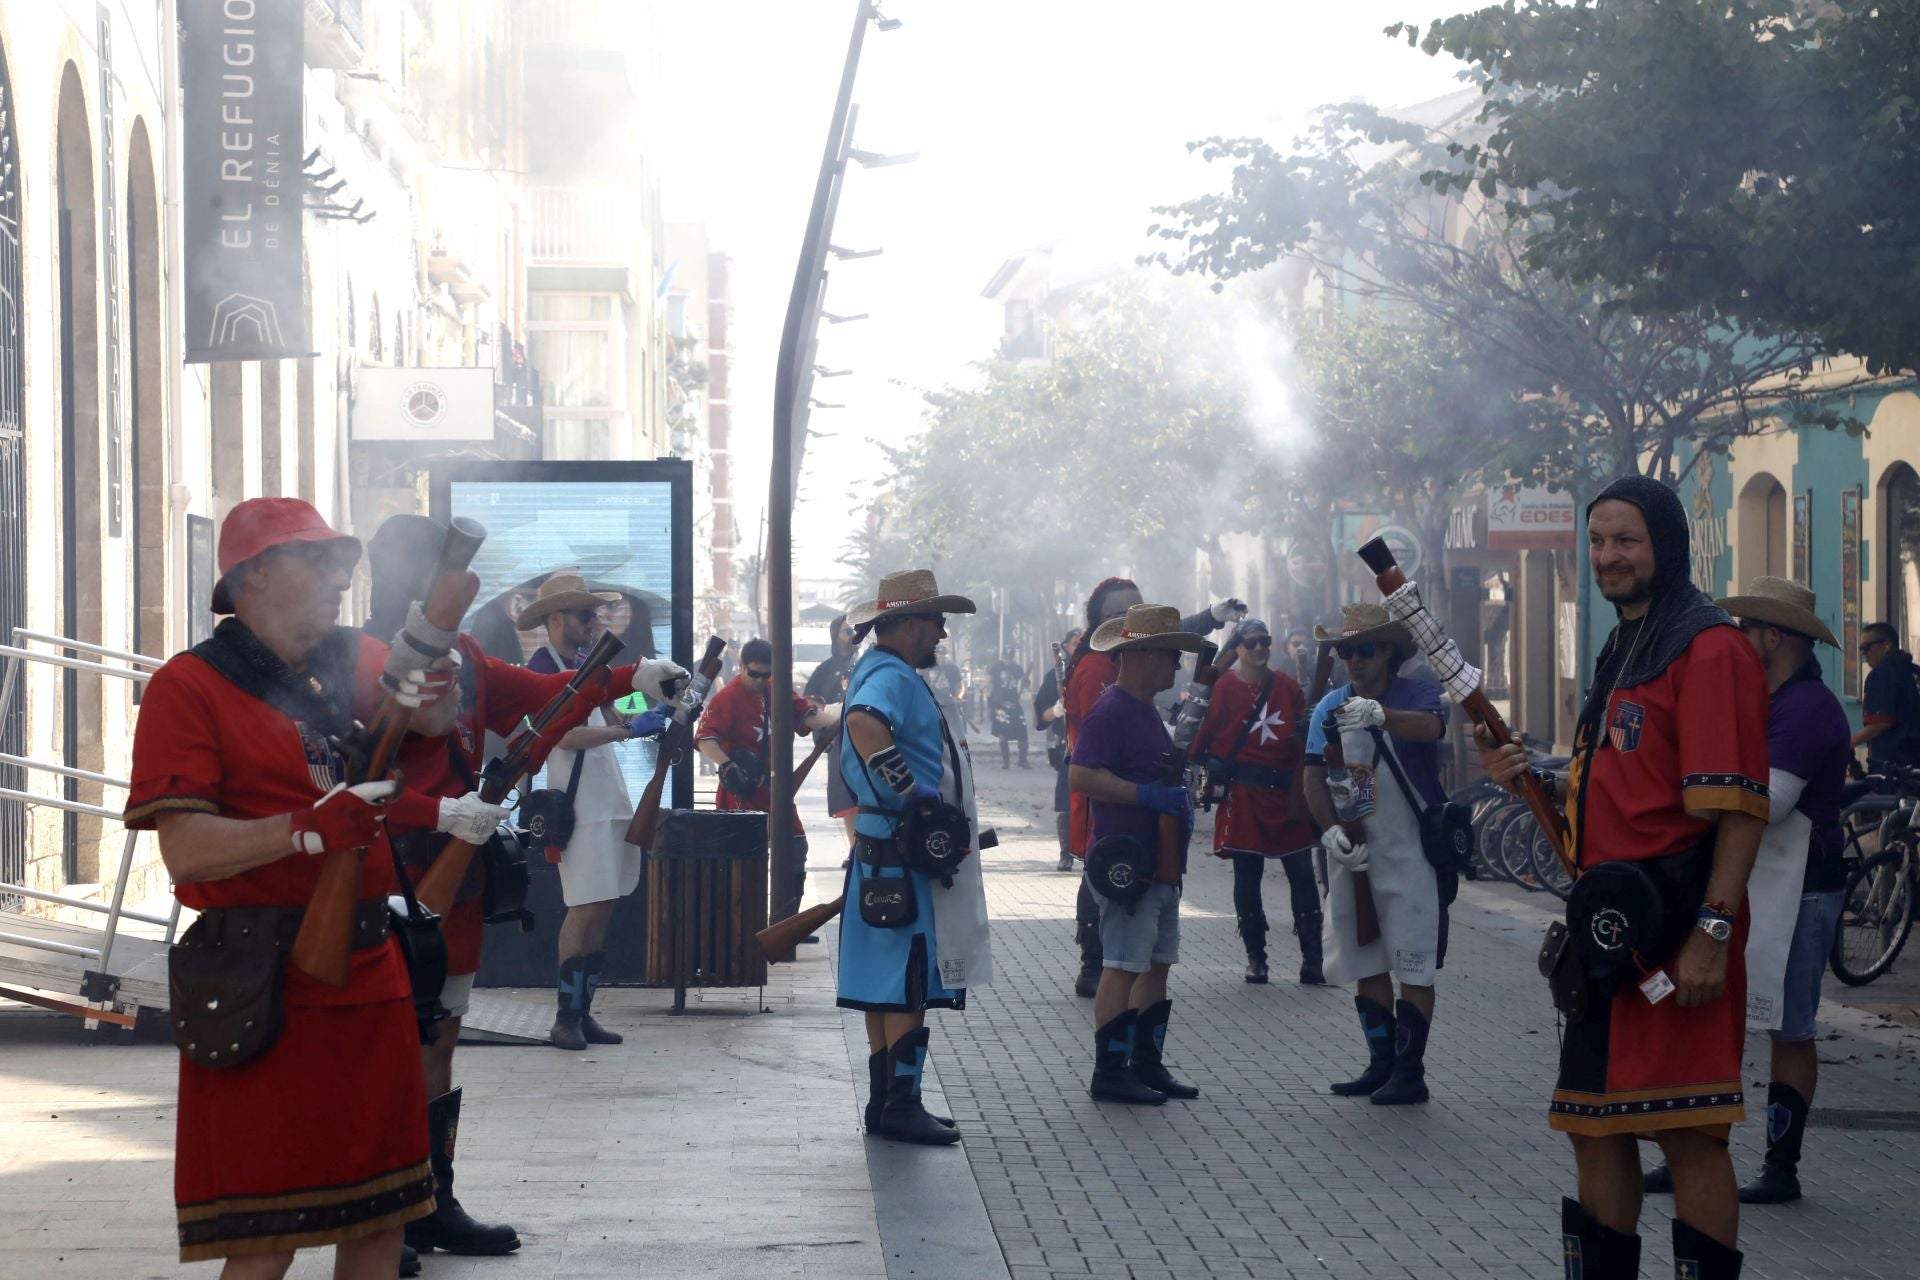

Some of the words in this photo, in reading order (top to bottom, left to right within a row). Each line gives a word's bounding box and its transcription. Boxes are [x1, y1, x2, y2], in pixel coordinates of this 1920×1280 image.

[221, 0, 255, 182] REFUGIO
[263, 134, 280, 206] DÉNIA
[221, 203, 252, 249] EL
[265, 223, 279, 249] DE
[102, 20, 121, 523] RESTAURANTE
[1520, 510, 1574, 524] EDES
[1689, 517, 1725, 557] ORIAN
[1691, 554, 1716, 593] RAY
